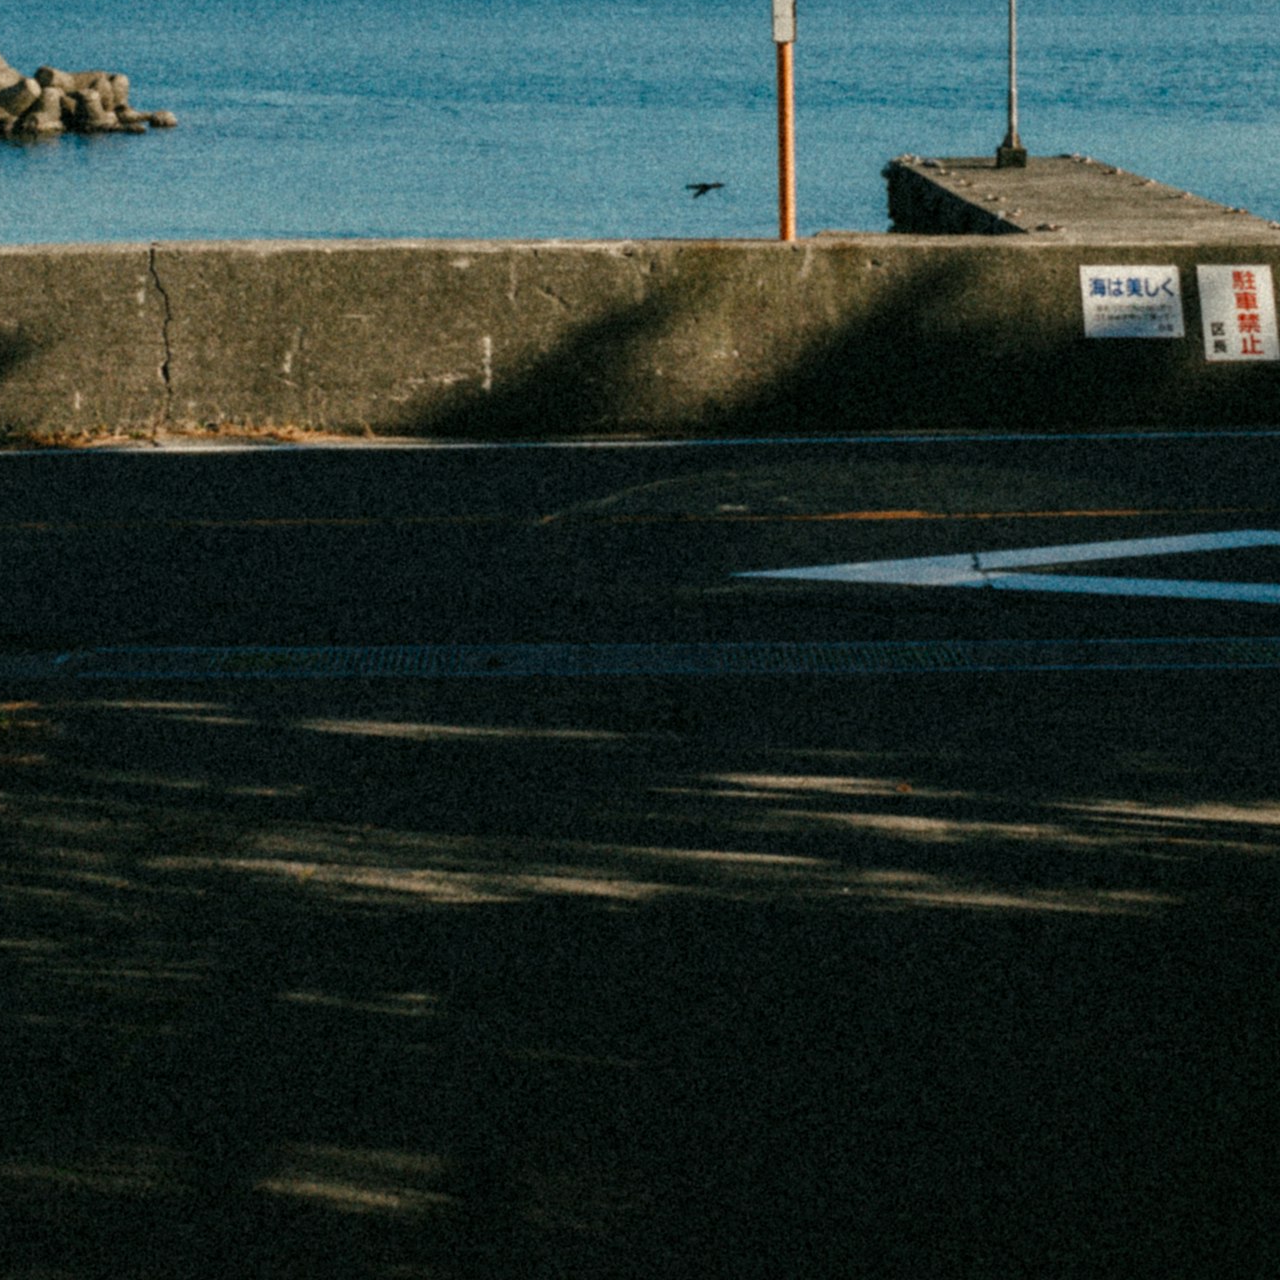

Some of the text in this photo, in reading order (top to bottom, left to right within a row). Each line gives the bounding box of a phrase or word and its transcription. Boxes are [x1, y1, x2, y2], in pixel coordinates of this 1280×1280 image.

[1089, 278, 1174, 297] 海は美しく
[1231, 271, 1265, 354] 駐車禁止
